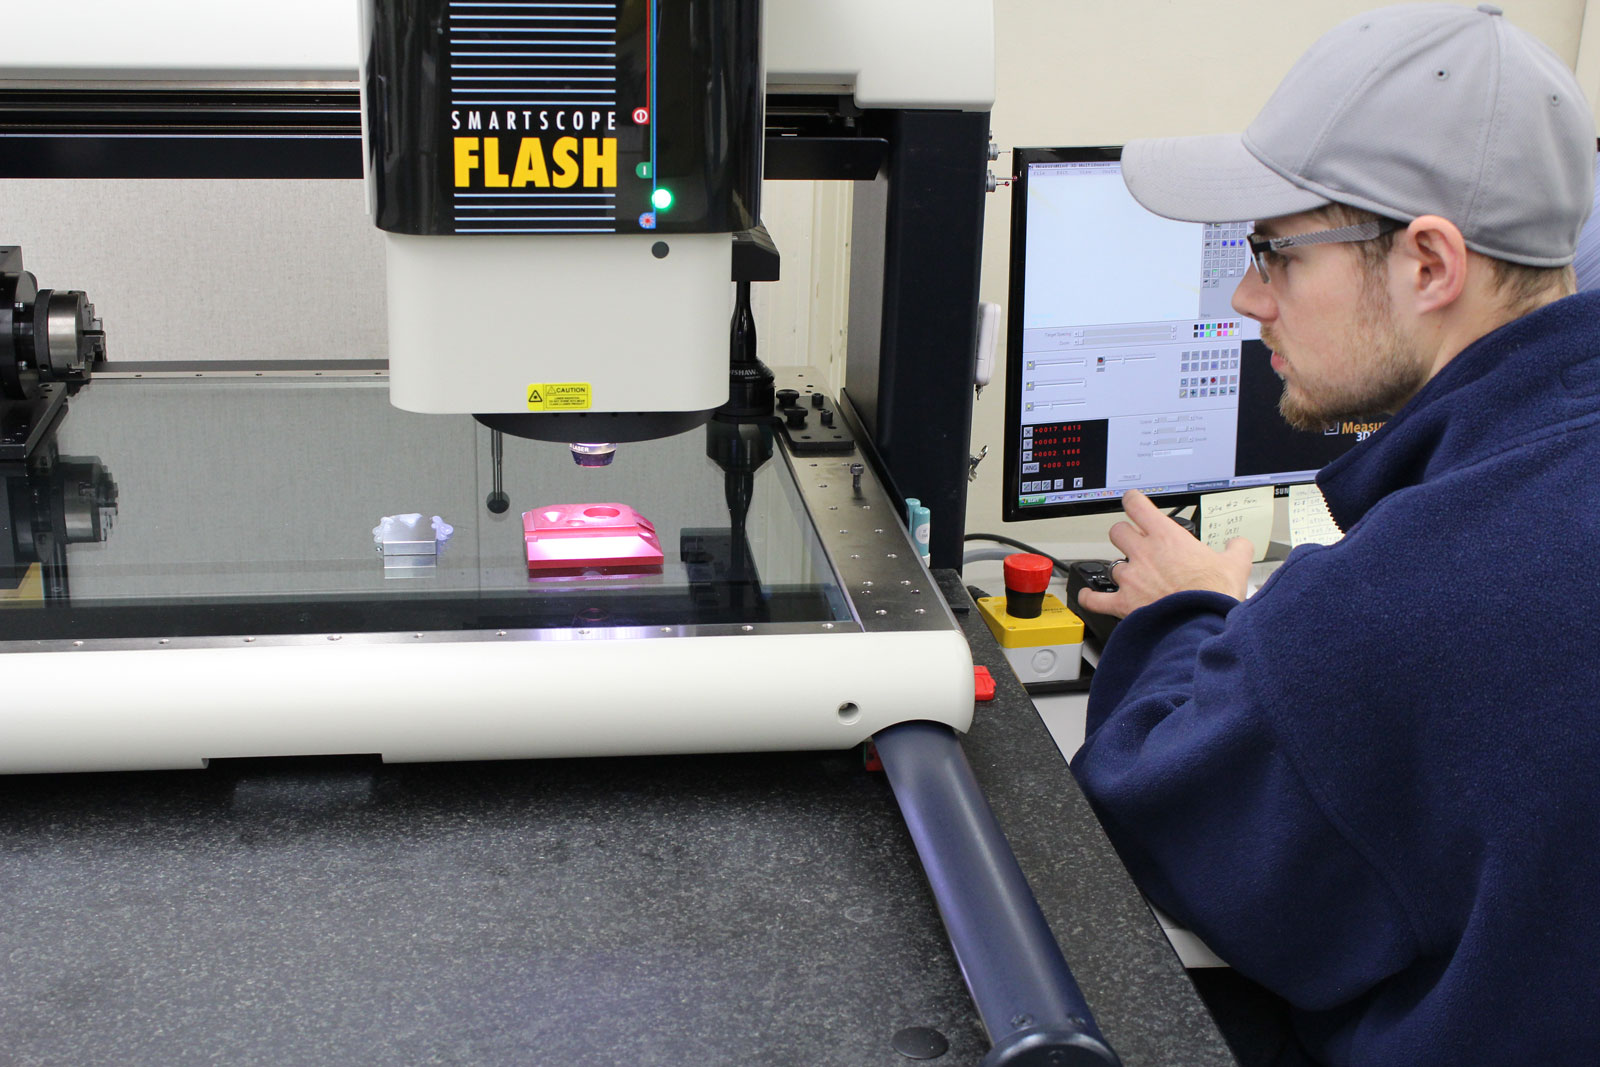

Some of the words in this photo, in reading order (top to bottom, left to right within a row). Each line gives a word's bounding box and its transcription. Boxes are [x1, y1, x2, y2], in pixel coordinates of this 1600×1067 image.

[451, 110, 616, 130] SMARTSCOPE
[453, 136, 618, 189] FLASH
[1356, 431, 1371, 442] 3D
[572, 443, 590, 453] LASER
[1025, 464, 1038, 472] ANG
